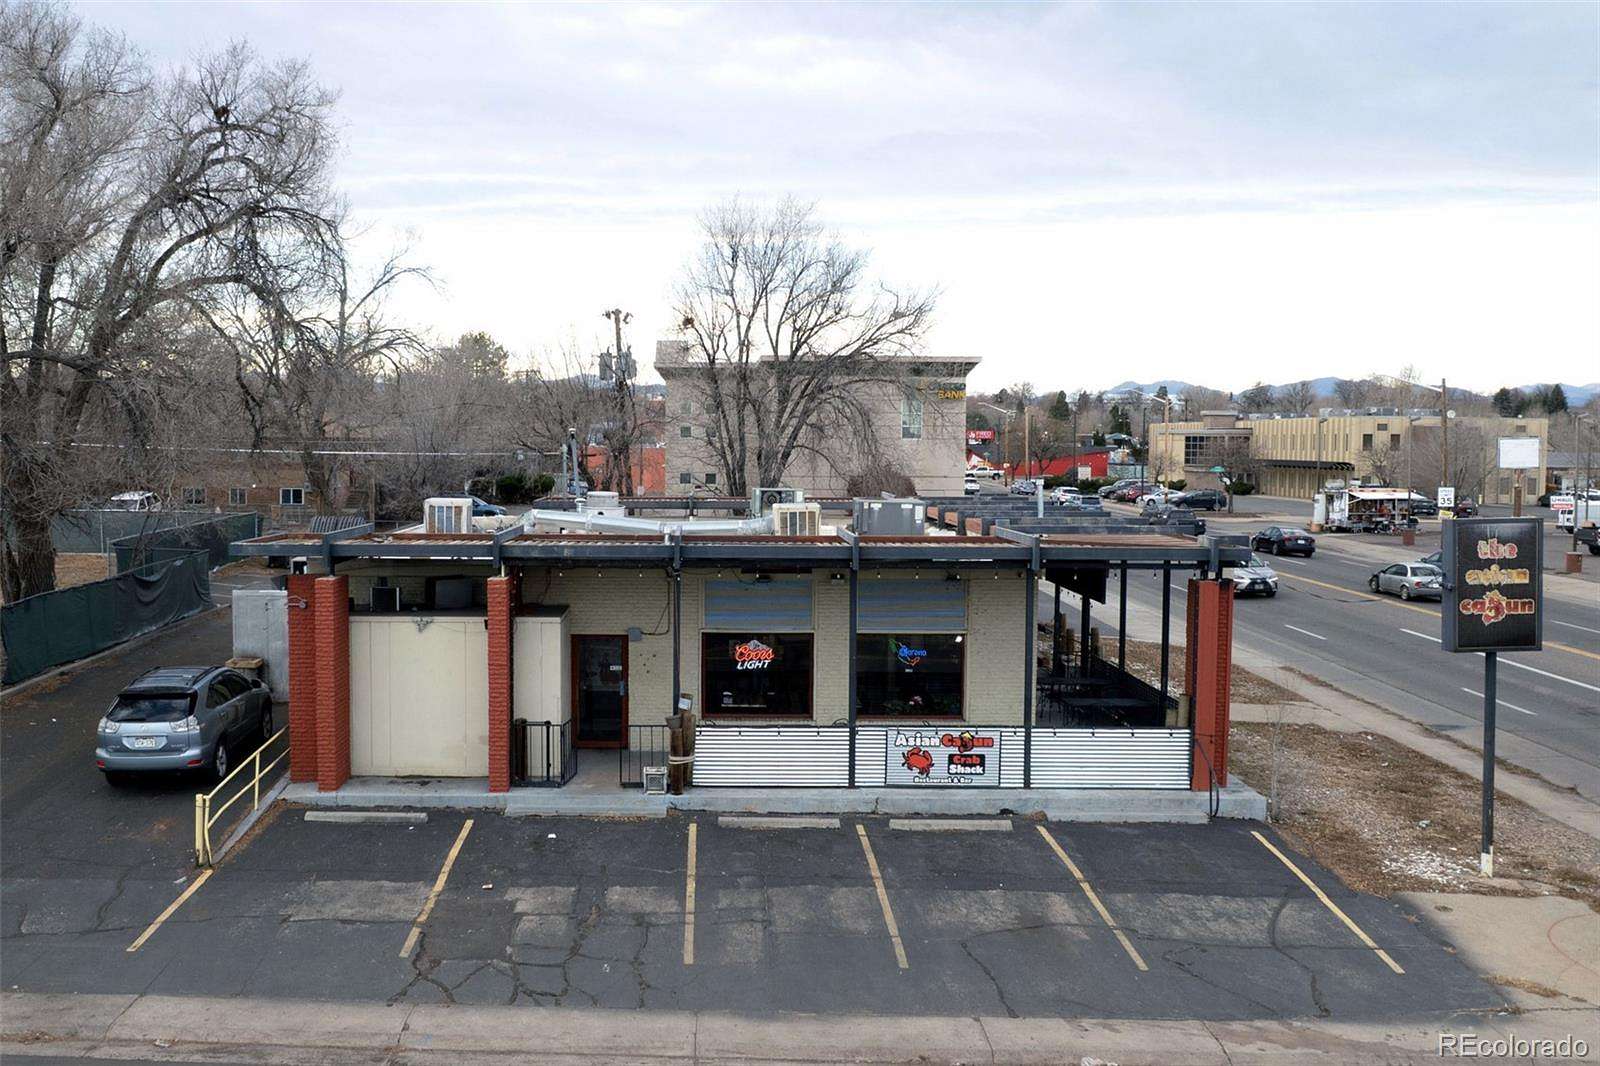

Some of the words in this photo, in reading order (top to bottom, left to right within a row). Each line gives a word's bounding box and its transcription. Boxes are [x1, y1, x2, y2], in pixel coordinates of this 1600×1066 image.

[938, 391, 966, 400] BANK
[1440, 497, 1452, 505] 35
[1477, 538, 1518, 559] the
[735, 645, 775, 661] Coors
[899, 645, 927, 656] Corona
[737, 660, 771, 670] LIGHT
[895, 732, 941, 747] Asian
[953, 755, 980, 764] Crab
[949, 764, 984, 774] Shack
